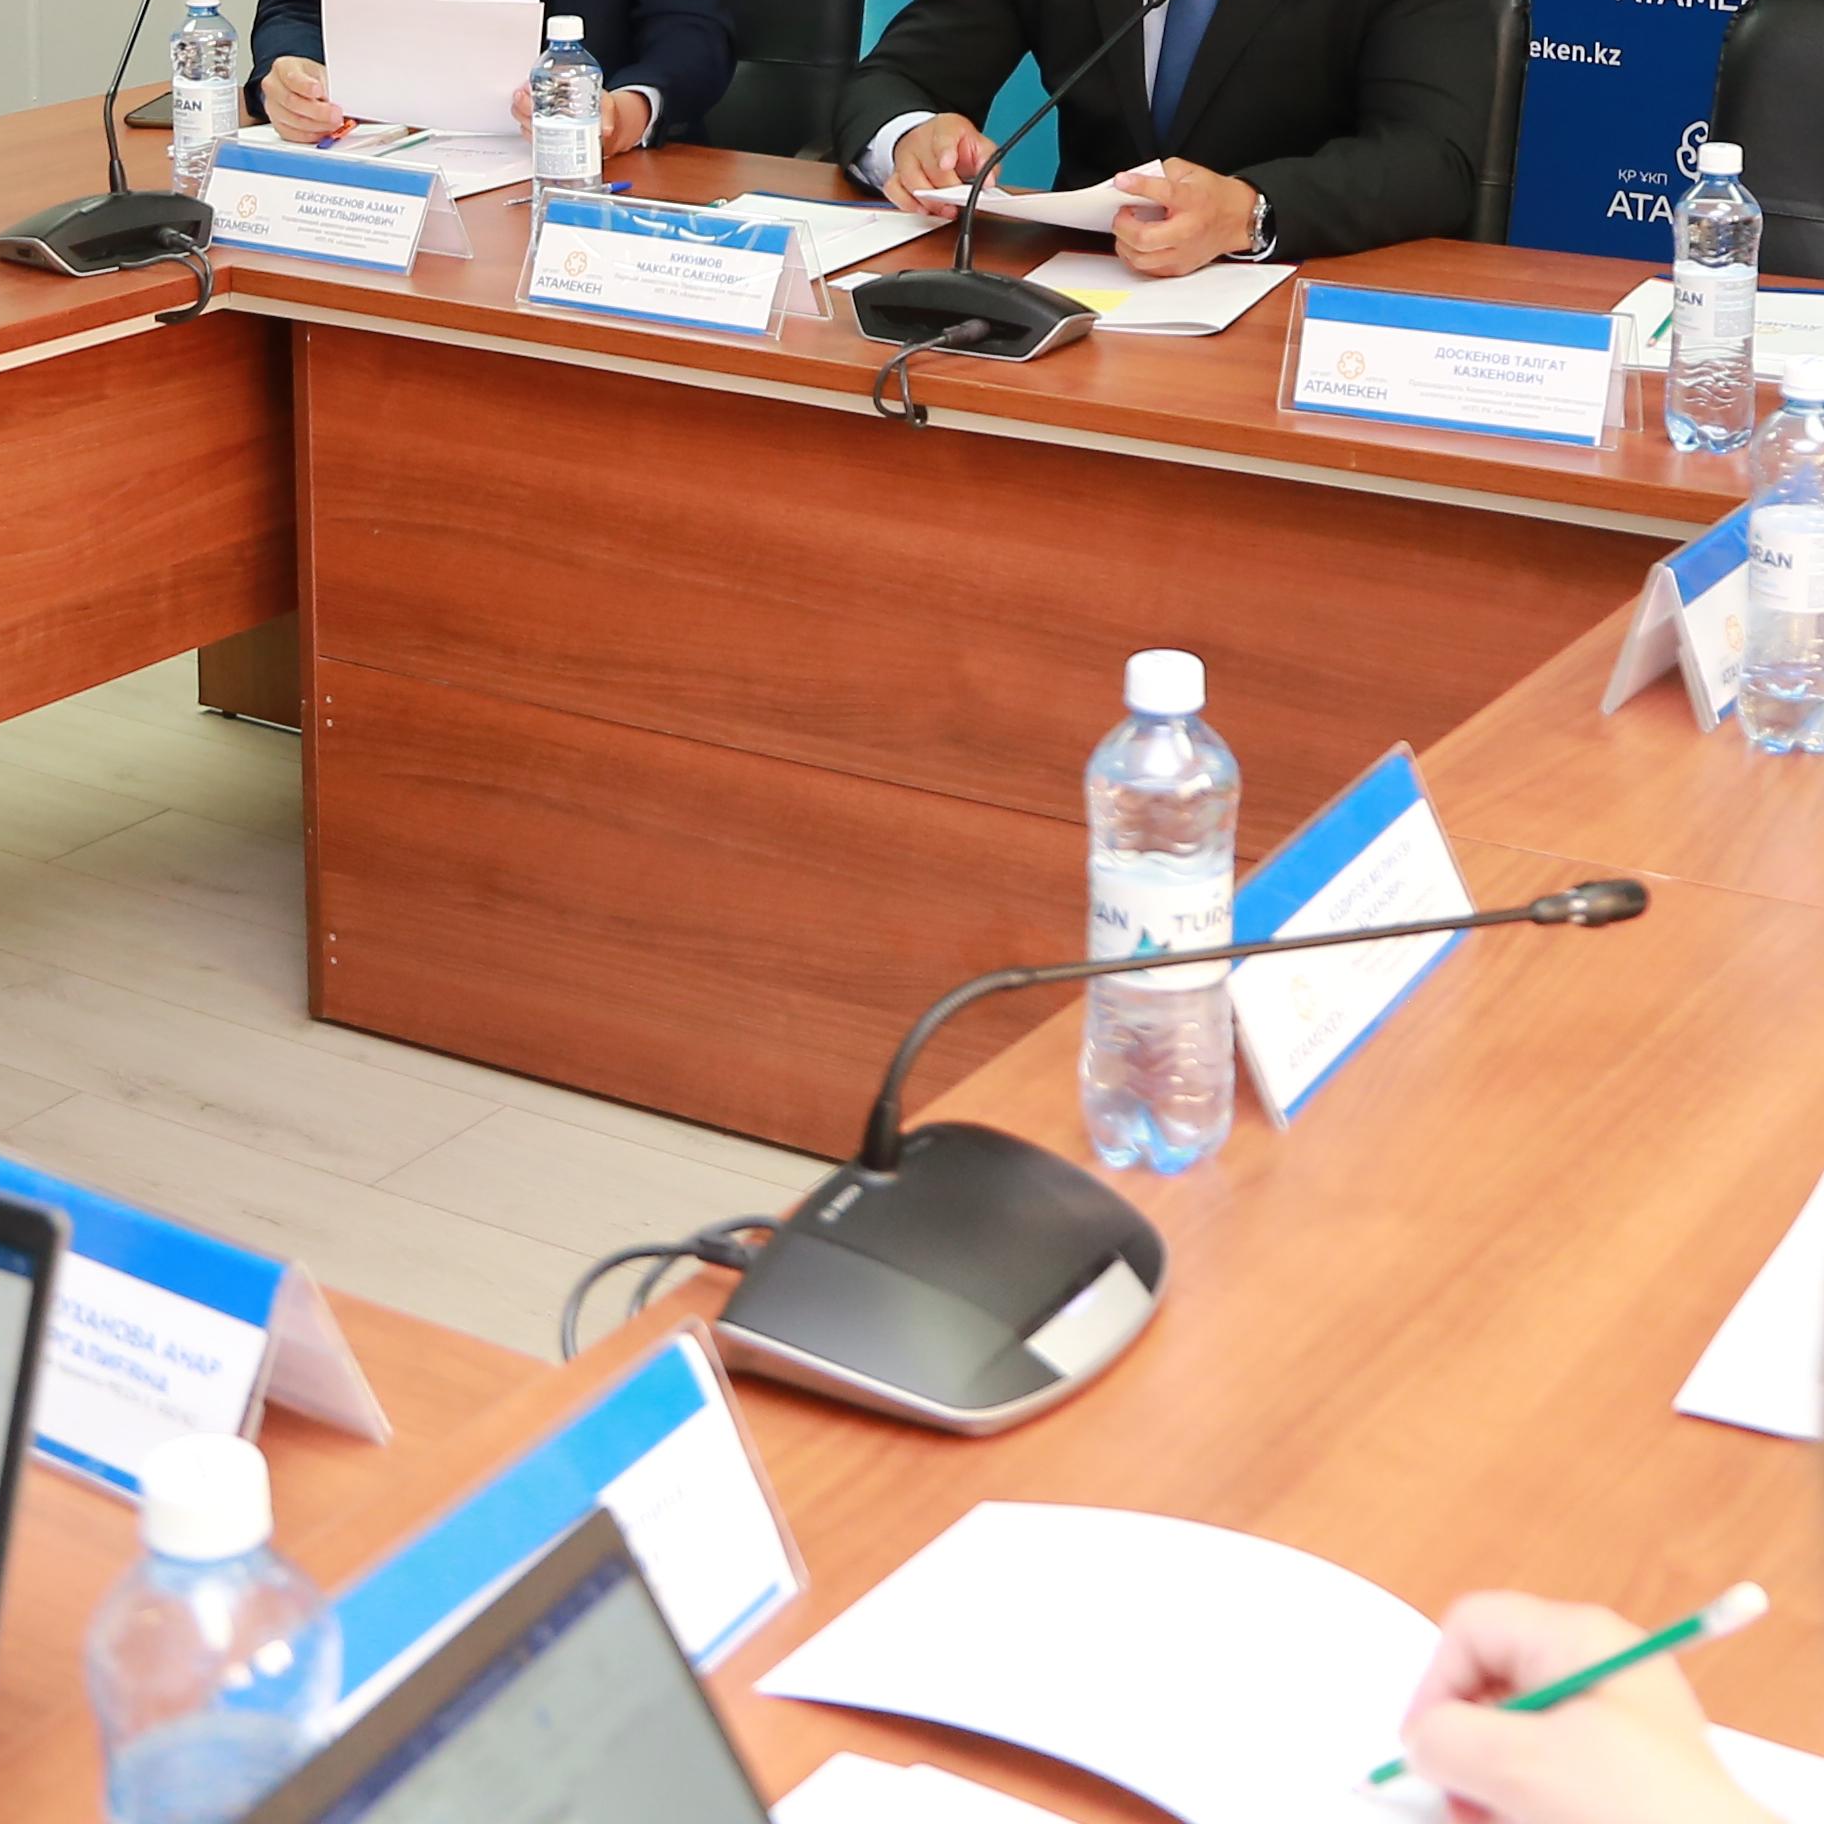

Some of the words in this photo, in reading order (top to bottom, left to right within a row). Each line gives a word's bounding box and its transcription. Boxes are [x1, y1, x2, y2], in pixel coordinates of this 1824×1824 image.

[174, 99, 202, 112] RAN
[297, 204, 395, 227] АМАНГЕЛЬДИНОВИЧ
[366, 200, 406, 217] АЗАМАТ
[212, 216, 270, 235] АТАМЕКЕН
[536, 275, 602, 296] АТАМЕКЕН
[1674, 287, 1704, 307] RAN
[1434, 346, 1511, 366] ДОСКЕНОВ
[1514, 355, 1567, 373] ТАЛГАТ
[1453, 364, 1545, 386] КАЗКЕНОВИЧ
[1303, 379, 1388, 401] АТАМЕКЕН
[1750, 542, 1794, 569] RAN
